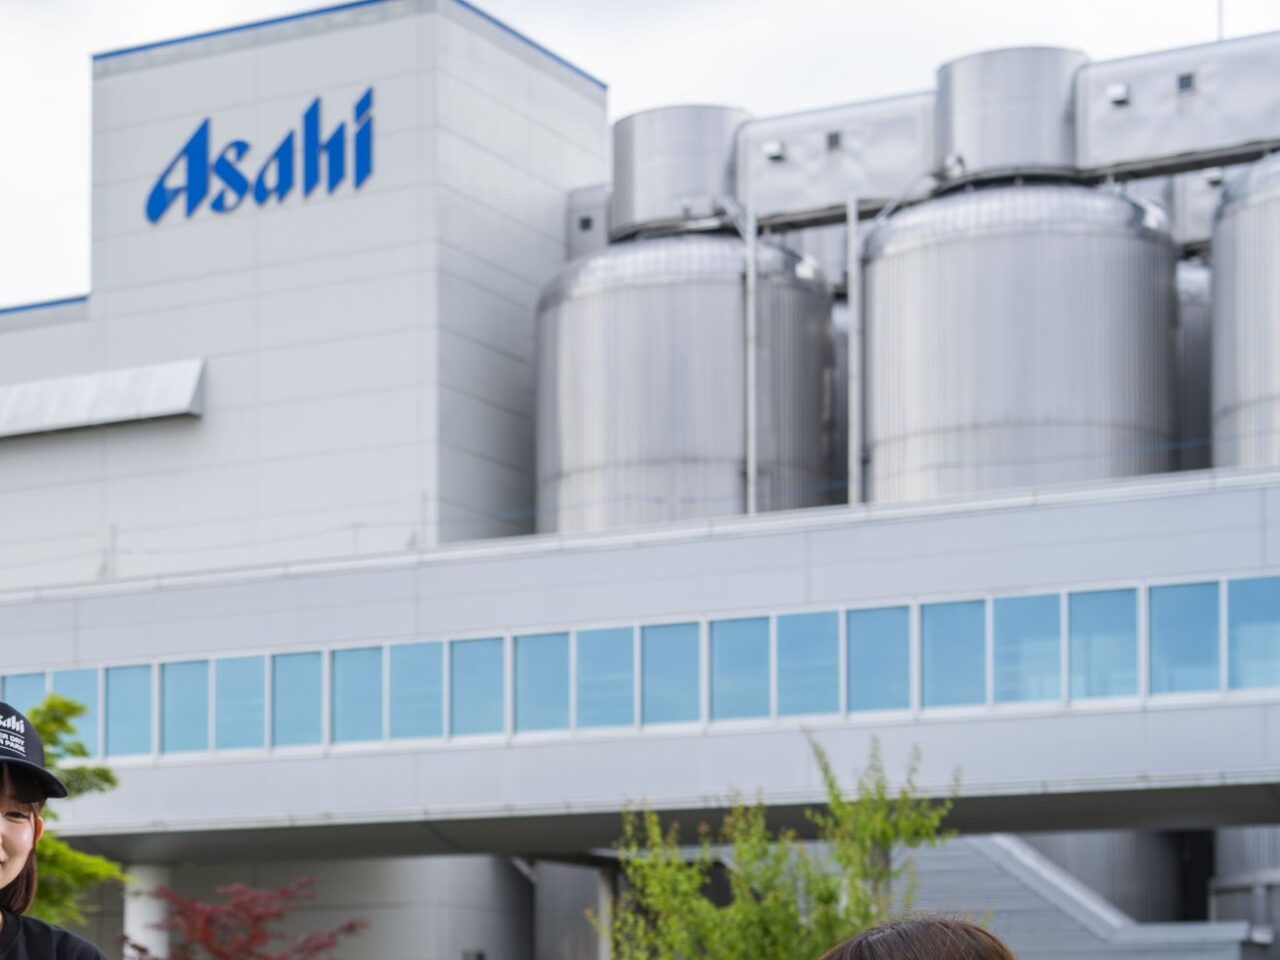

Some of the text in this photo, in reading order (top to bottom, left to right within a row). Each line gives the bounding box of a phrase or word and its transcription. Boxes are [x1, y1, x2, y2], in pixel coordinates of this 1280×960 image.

[144, 86, 374, 225] Asahi
[4, 740, 26, 753] PARK
[9, 735, 25, 746] DRY
